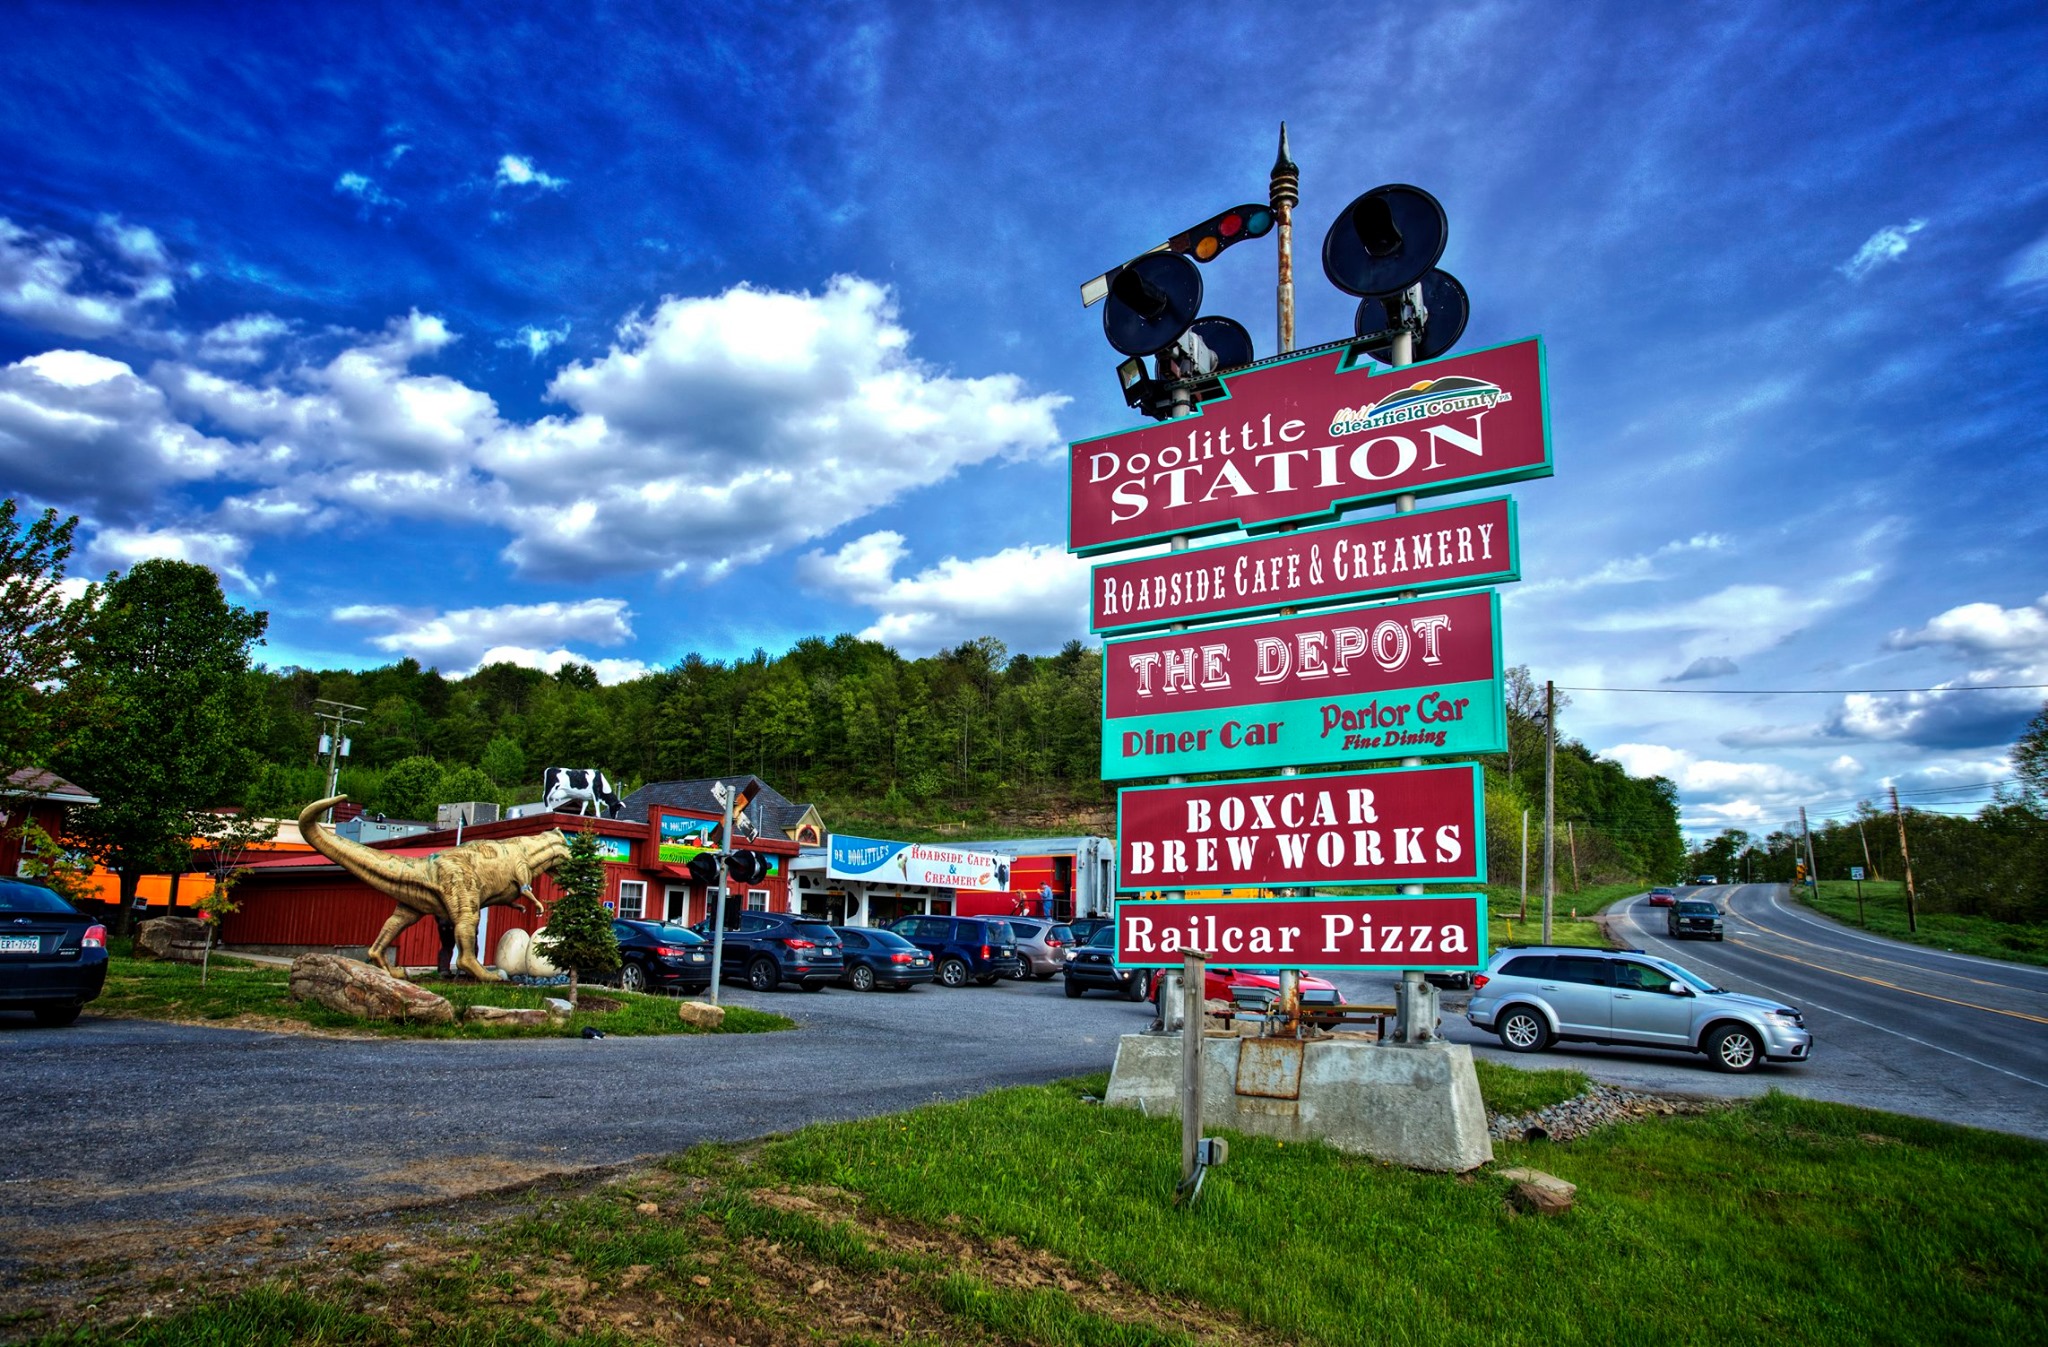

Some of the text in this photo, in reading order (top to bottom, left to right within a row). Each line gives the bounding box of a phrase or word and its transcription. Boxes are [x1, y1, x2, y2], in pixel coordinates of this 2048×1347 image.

[1334, 403, 1374, 422] Visit
[1090, 413, 1306, 483] Doolittle
[1111, 410, 1490, 525] STATION
[1103, 565, 1226, 616] ROADSIDE
[1309, 543, 1325, 585] &
[1333, 523, 1494, 582] CREAMERY
[1129, 613, 1452, 698] THE DEPOT
[1320, 691, 1470, 739] Parlor Car
[1122, 720, 1285, 758] Diner Car
[1342, 728, 1447, 751] Fine Dining
[1186, 788, 1379, 834] BOXCAR
[834, 844, 889, 866] DR. DOOLITTLE'S
[911, 846, 991, 867] ROADSIDE CAFE
[949, 864, 957, 874] &
[1130, 824, 1462, 875] BREW WORKS
[924, 871, 977, 887] CREAMERY
[1124, 913, 1469, 954] Railcar Pizza
